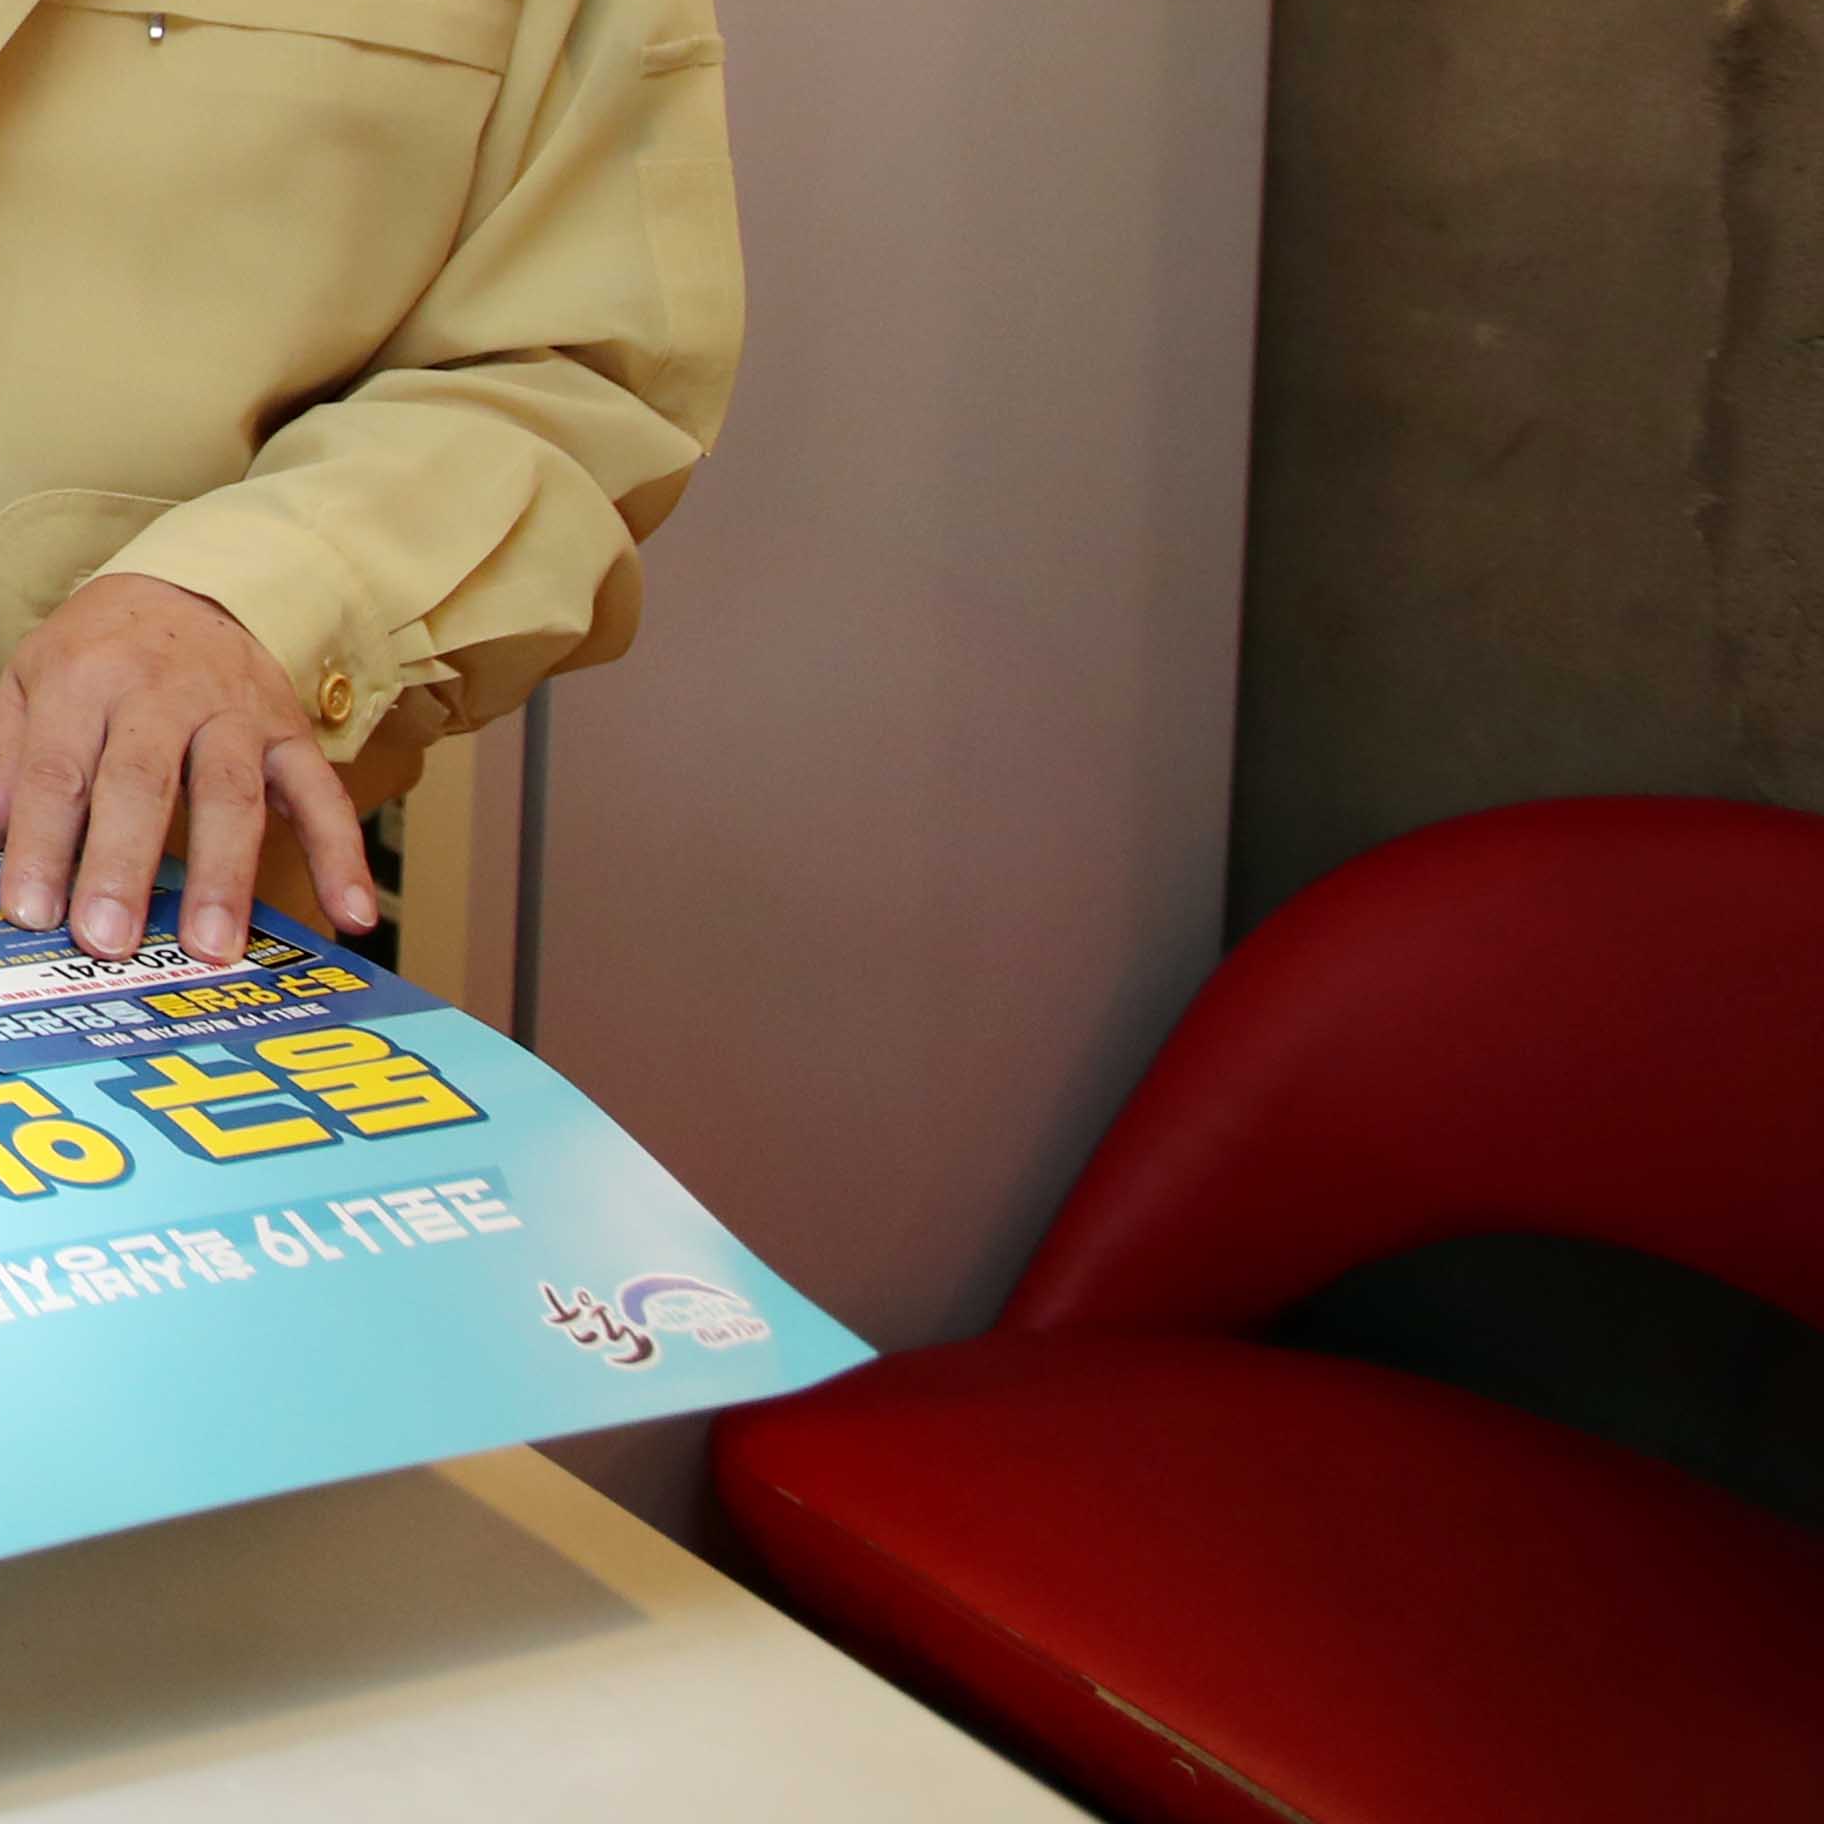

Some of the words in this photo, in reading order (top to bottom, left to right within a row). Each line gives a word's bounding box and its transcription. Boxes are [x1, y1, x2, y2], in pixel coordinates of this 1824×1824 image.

[40, 947, 190, 980] 80-341-
[140, 981, 284, 1019] 안심콜
[275, 966, 371, 999] 동구
[125, 1026, 478, 1162] 동구
